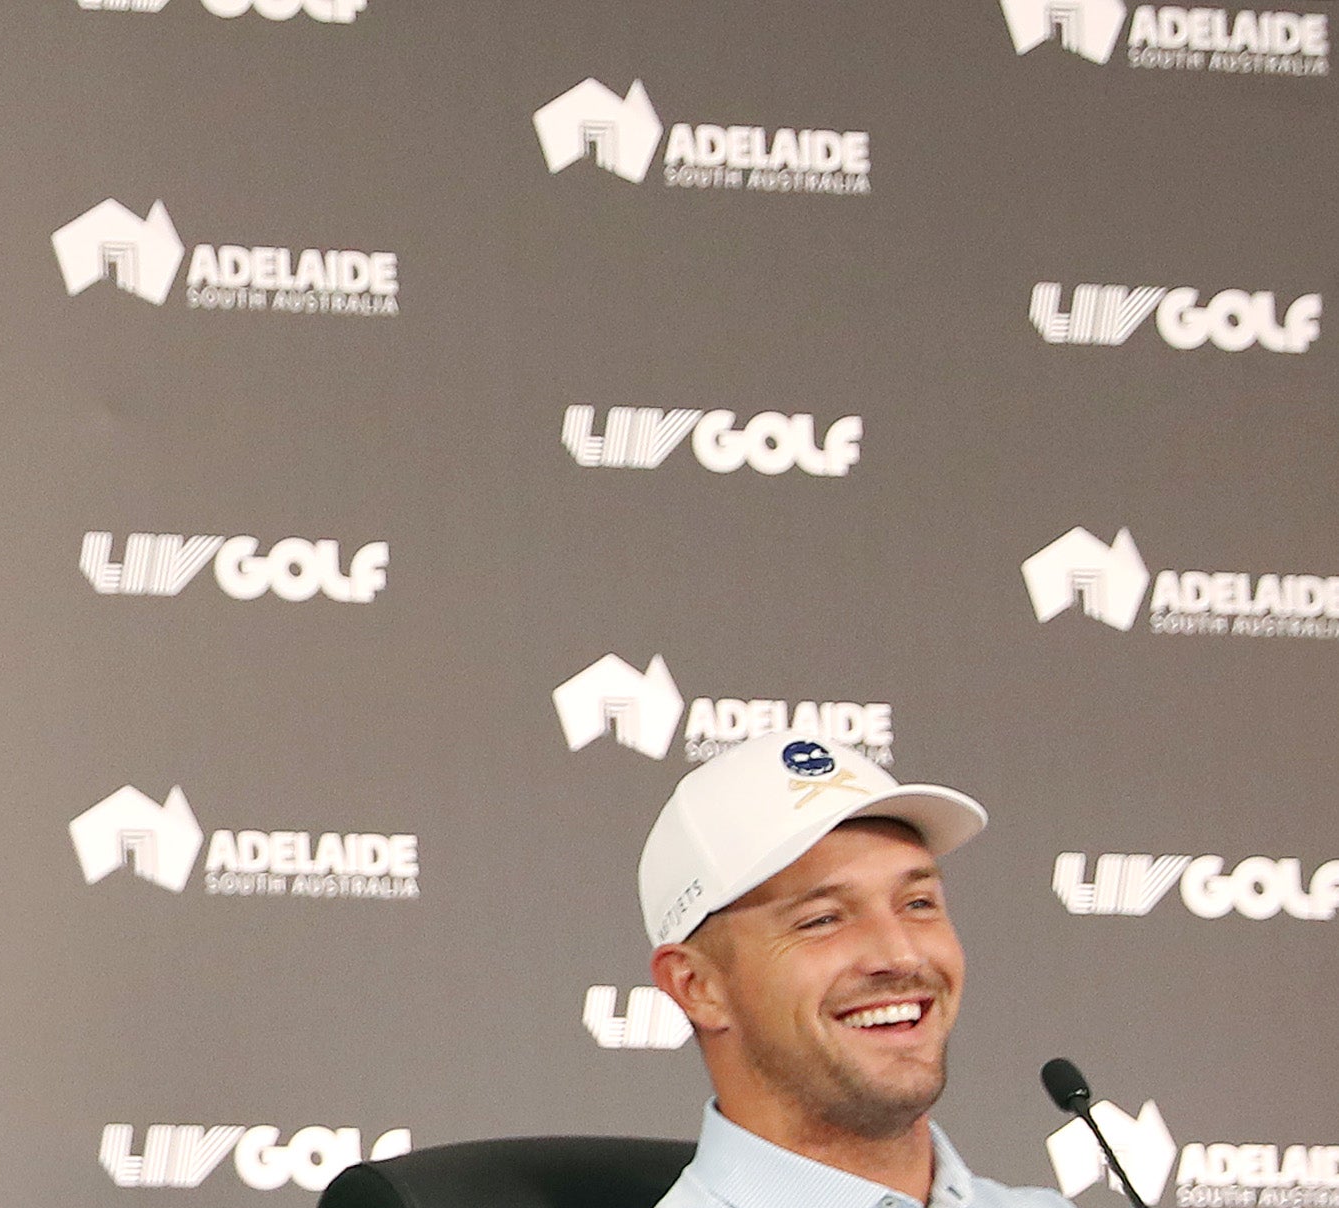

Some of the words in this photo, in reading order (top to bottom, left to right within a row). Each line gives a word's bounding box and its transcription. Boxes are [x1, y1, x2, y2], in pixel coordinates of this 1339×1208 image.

[1127, 5, 1327, 56] ADELAIDE
[1128, 46, 1204, 70] SOUTH
[1208, 50, 1329, 77] AUSTRALIA
[664, 123, 871, 174] ADELAIDE
[663, 163, 743, 189] SOUTH
[747, 168, 870, 195] AUSTRALIA
[186, 244, 399, 295] ADELAIDE
[186, 285, 267, 311] SOUTH
[272, 289, 399, 316] AUSTRALIA
[1030, 282, 1168, 345] LIV
[1156, 287, 1322, 353] GOLF
[561, 405, 703, 469] LIV
[692, 409, 863, 477] GOLF
[79, 531, 225, 595] LIV
[214, 536, 389, 602] GOLF
[1150, 610, 1228, 635] SOUTH
[685, 696, 894, 747] ADELAIDE
[205, 829, 420, 878] ADELAIDE
[205, 870, 287, 896] SOUTH
[290, 873, 420, 899] AUSTRALIA
[1052, 852, 1193, 916] LIV
[1180, 855, 1339, 920] GOLF
[99, 1123, 247, 1188] LIV
[1176, 1143, 1339, 1189] ADELAID
